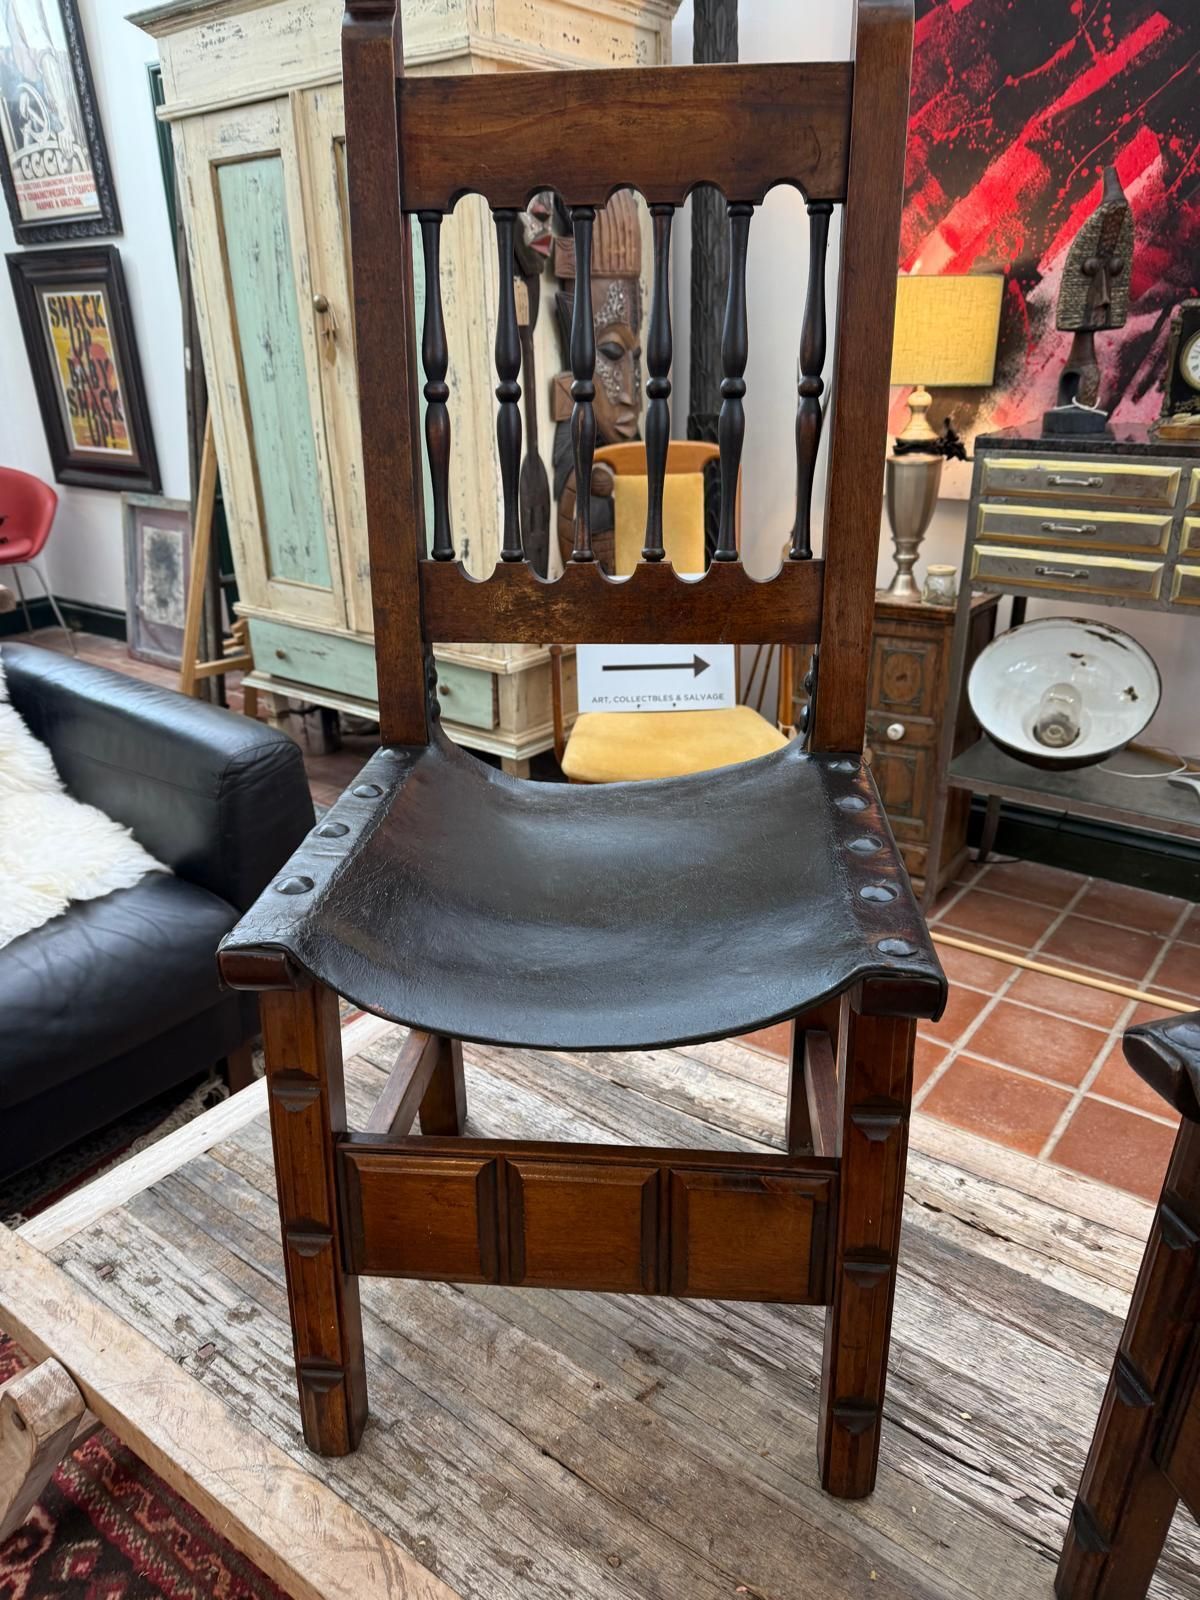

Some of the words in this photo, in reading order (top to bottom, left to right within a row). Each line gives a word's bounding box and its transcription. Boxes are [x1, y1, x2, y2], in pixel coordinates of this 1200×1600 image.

[47, 294, 107, 328] SHACK
[68, 323, 93, 365] UP
[67, 356, 111, 388] BABY
[66, 388, 124, 421] SHACK
[592, 696, 611, 704] ART,
[675, 693, 682, 701] &
[684, 692, 725, 702] SALVAGE
